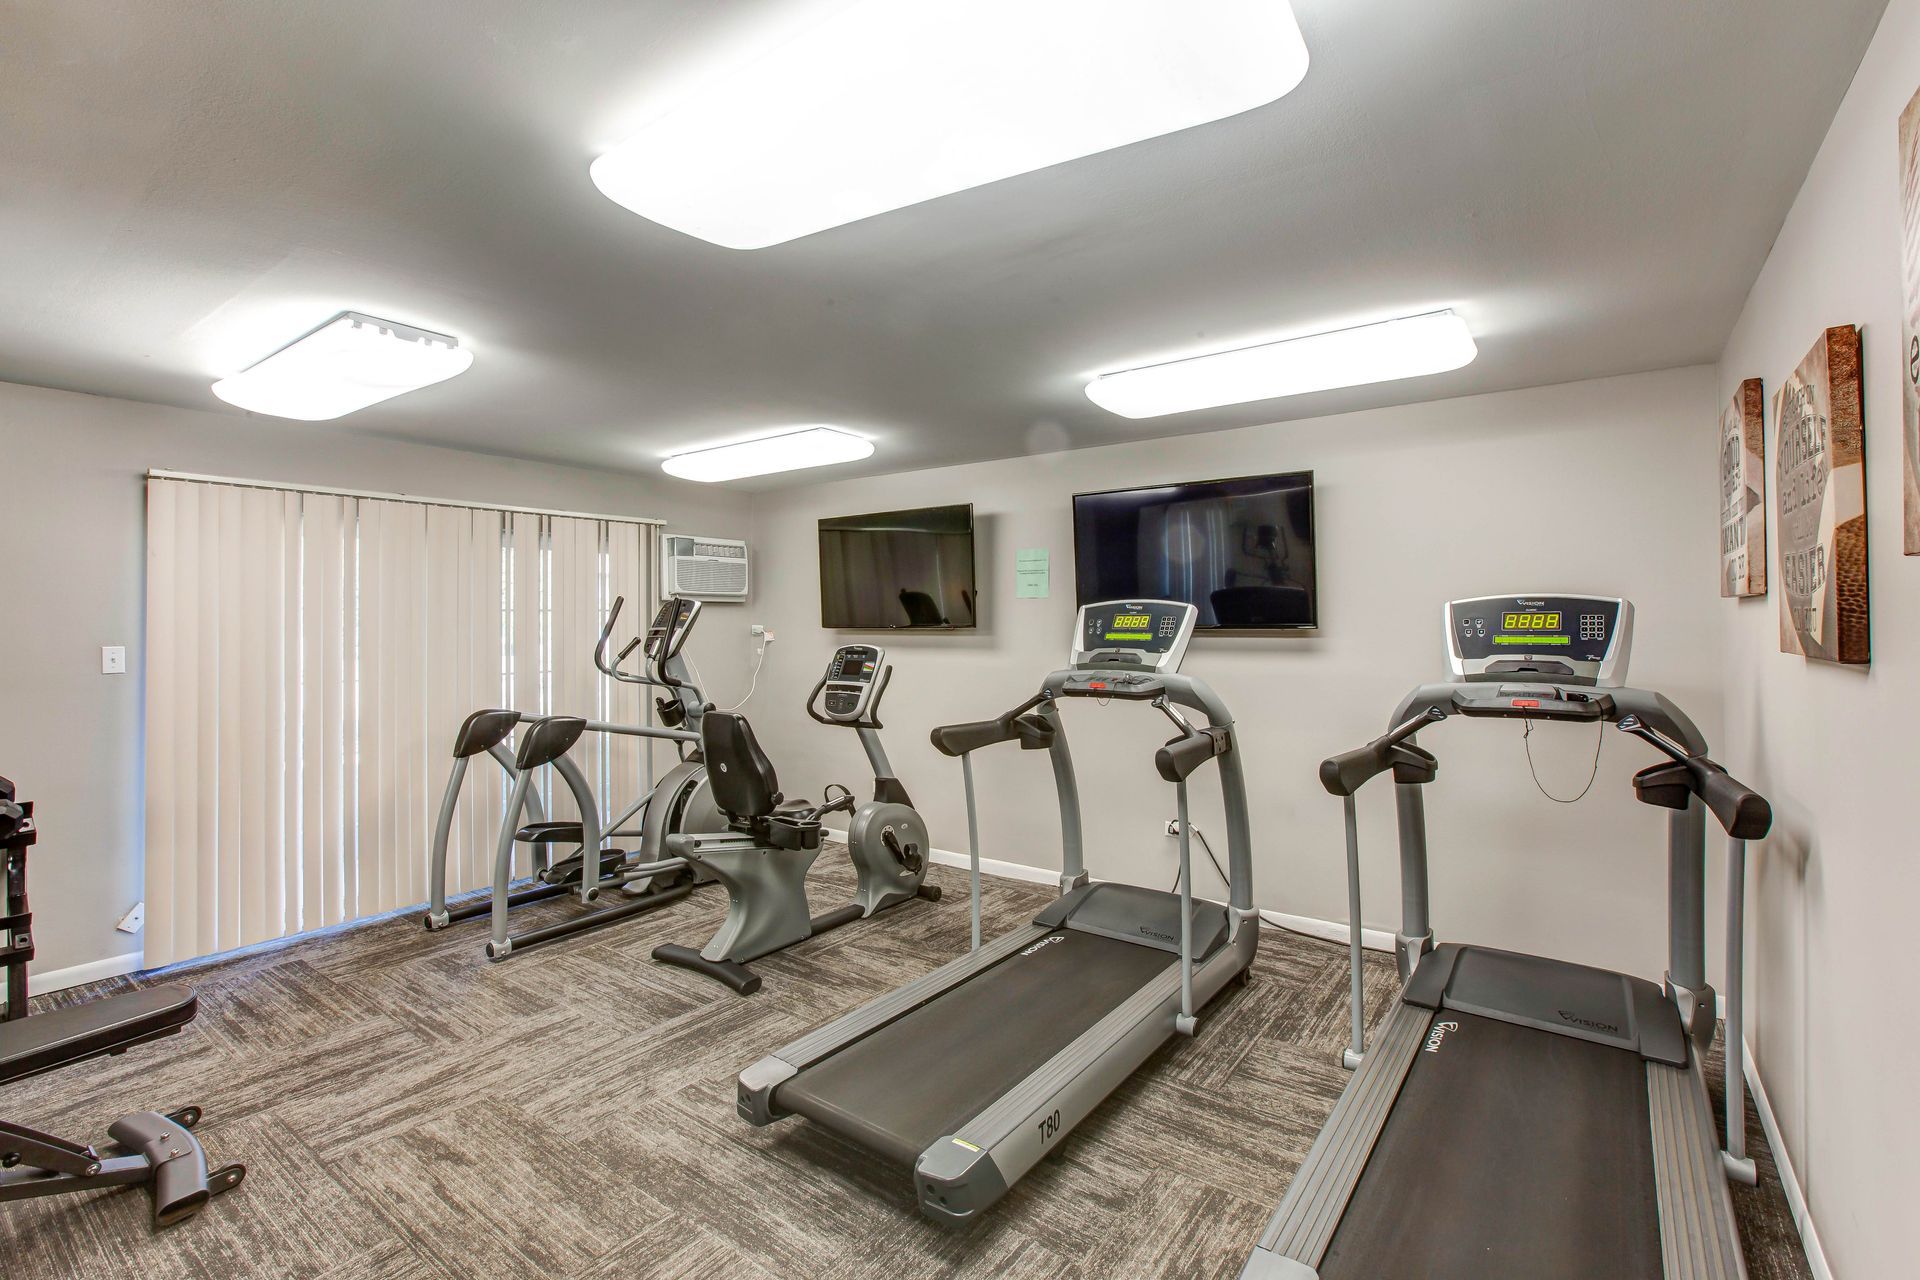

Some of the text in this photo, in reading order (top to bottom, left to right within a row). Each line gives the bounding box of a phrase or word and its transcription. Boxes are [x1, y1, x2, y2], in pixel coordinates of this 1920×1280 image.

[1778, 414, 1826, 482] YOURSELF
[1784, 545, 1825, 595] EASIER
[1424, 1024, 1446, 1053] VISION
[1569, 1017, 1618, 1032] VISION
[1038, 1109, 1060, 1144] T80
